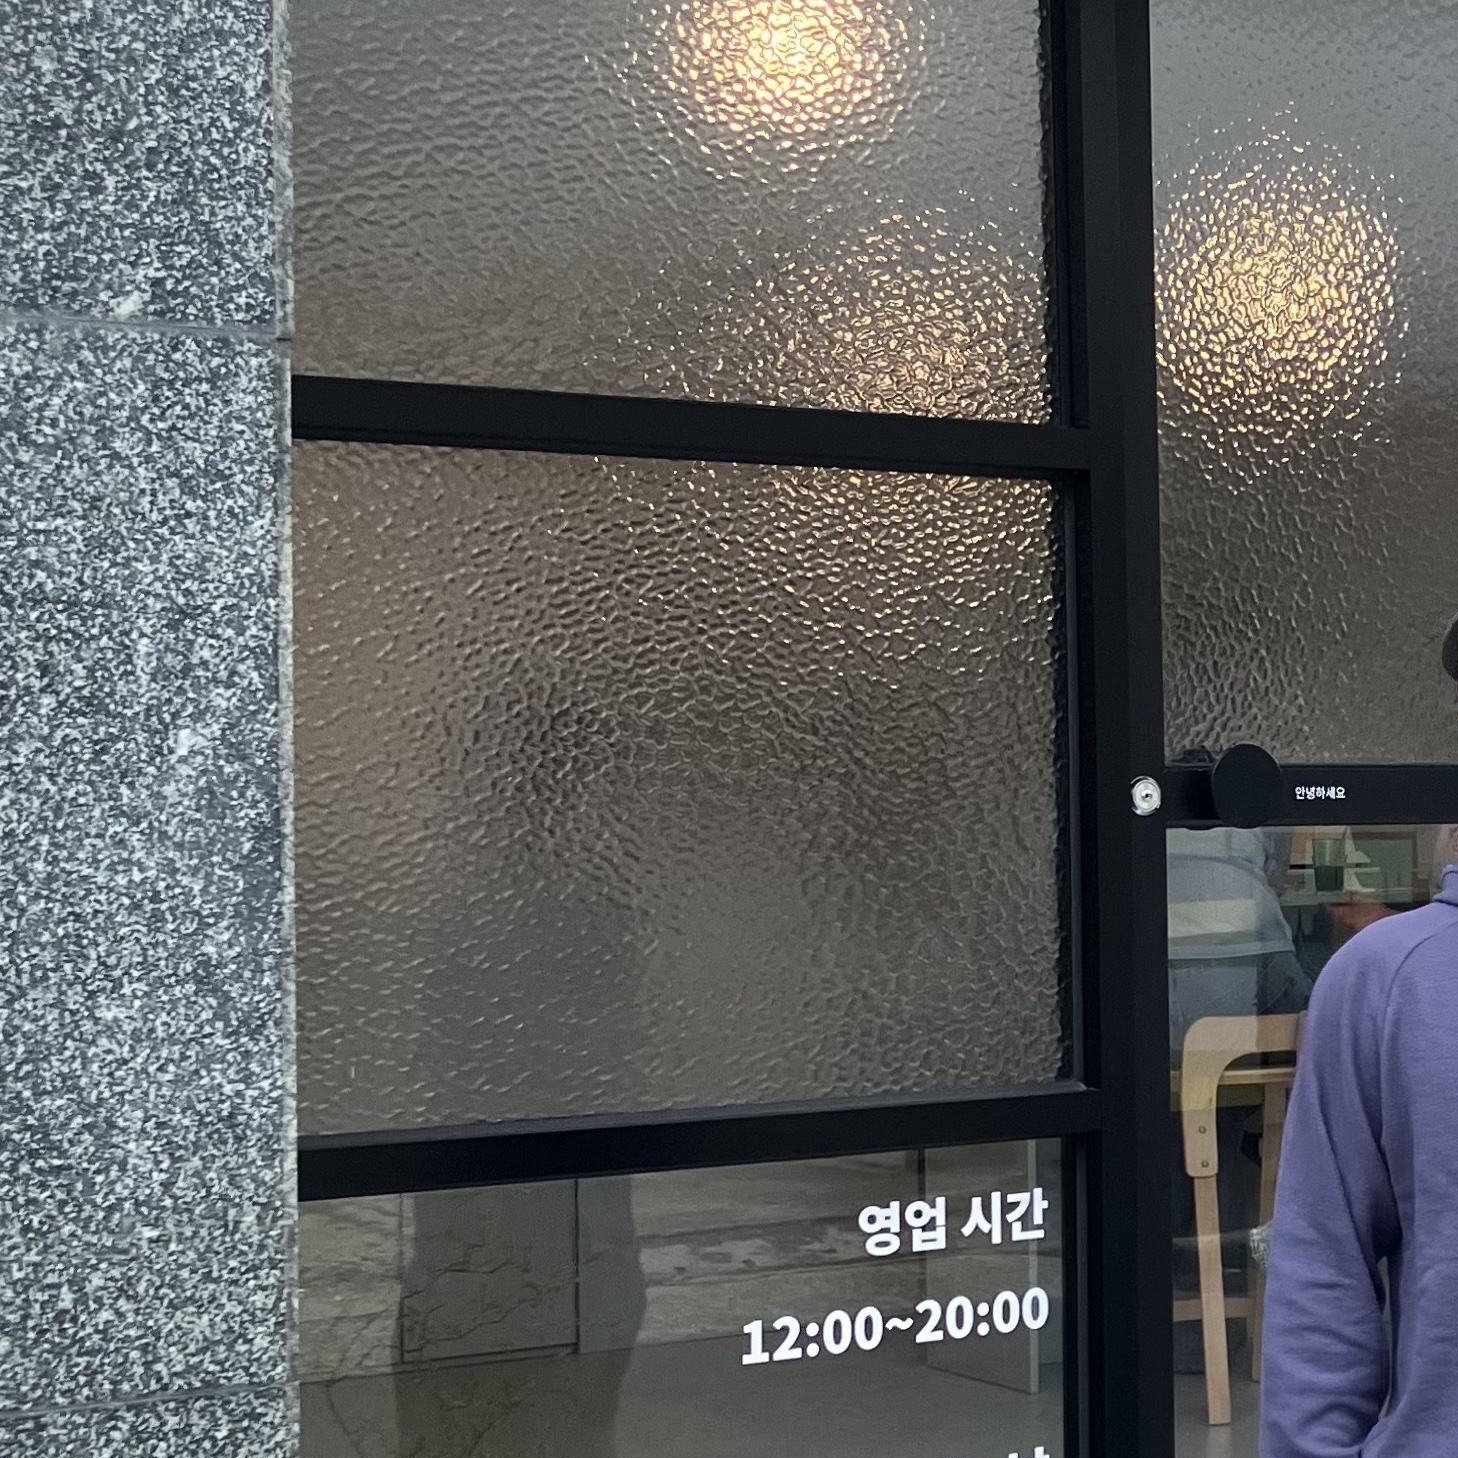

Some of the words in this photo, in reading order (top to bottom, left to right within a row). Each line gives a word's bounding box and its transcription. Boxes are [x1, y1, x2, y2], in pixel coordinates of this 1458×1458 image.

[1294, 785, 1346, 800] 안녕하세요
[858, 1196, 946, 1256] 영업
[961, 1187, 1049, 1244] 시간
[742, 1287, 1049, 1365] 12:00~20:00
